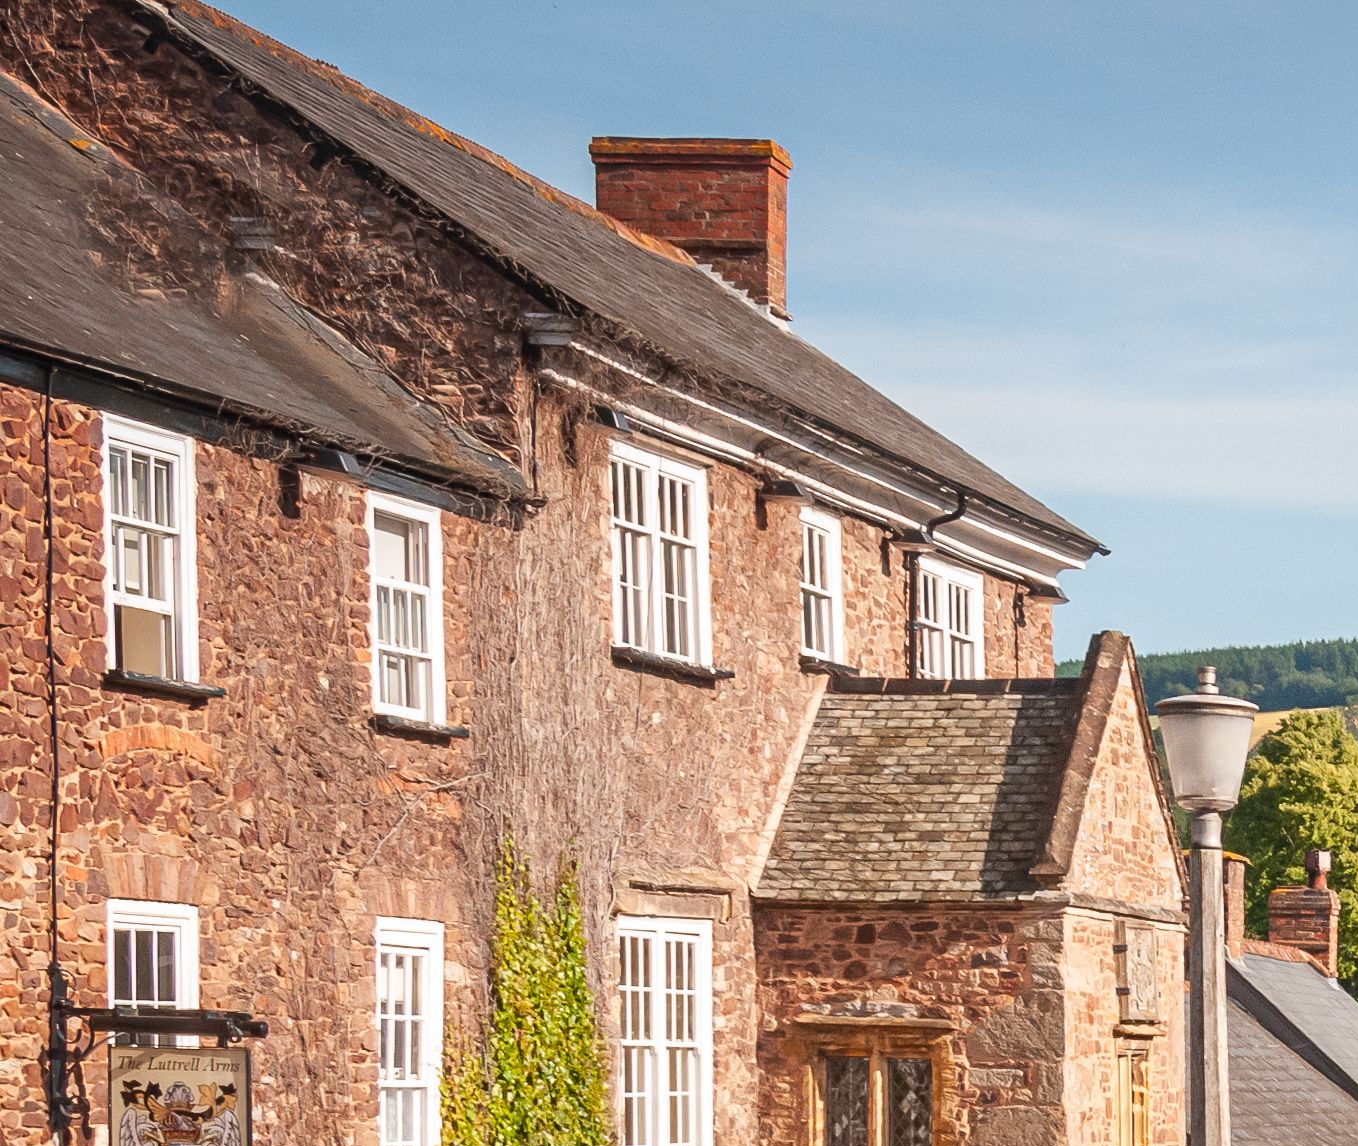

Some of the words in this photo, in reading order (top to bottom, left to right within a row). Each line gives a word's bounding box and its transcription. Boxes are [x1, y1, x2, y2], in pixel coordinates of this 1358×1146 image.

[118, 1055, 141, 1070] The
[147, 1056, 200, 1072] Luttrell
[202, 1057, 241, 1073] Arms
